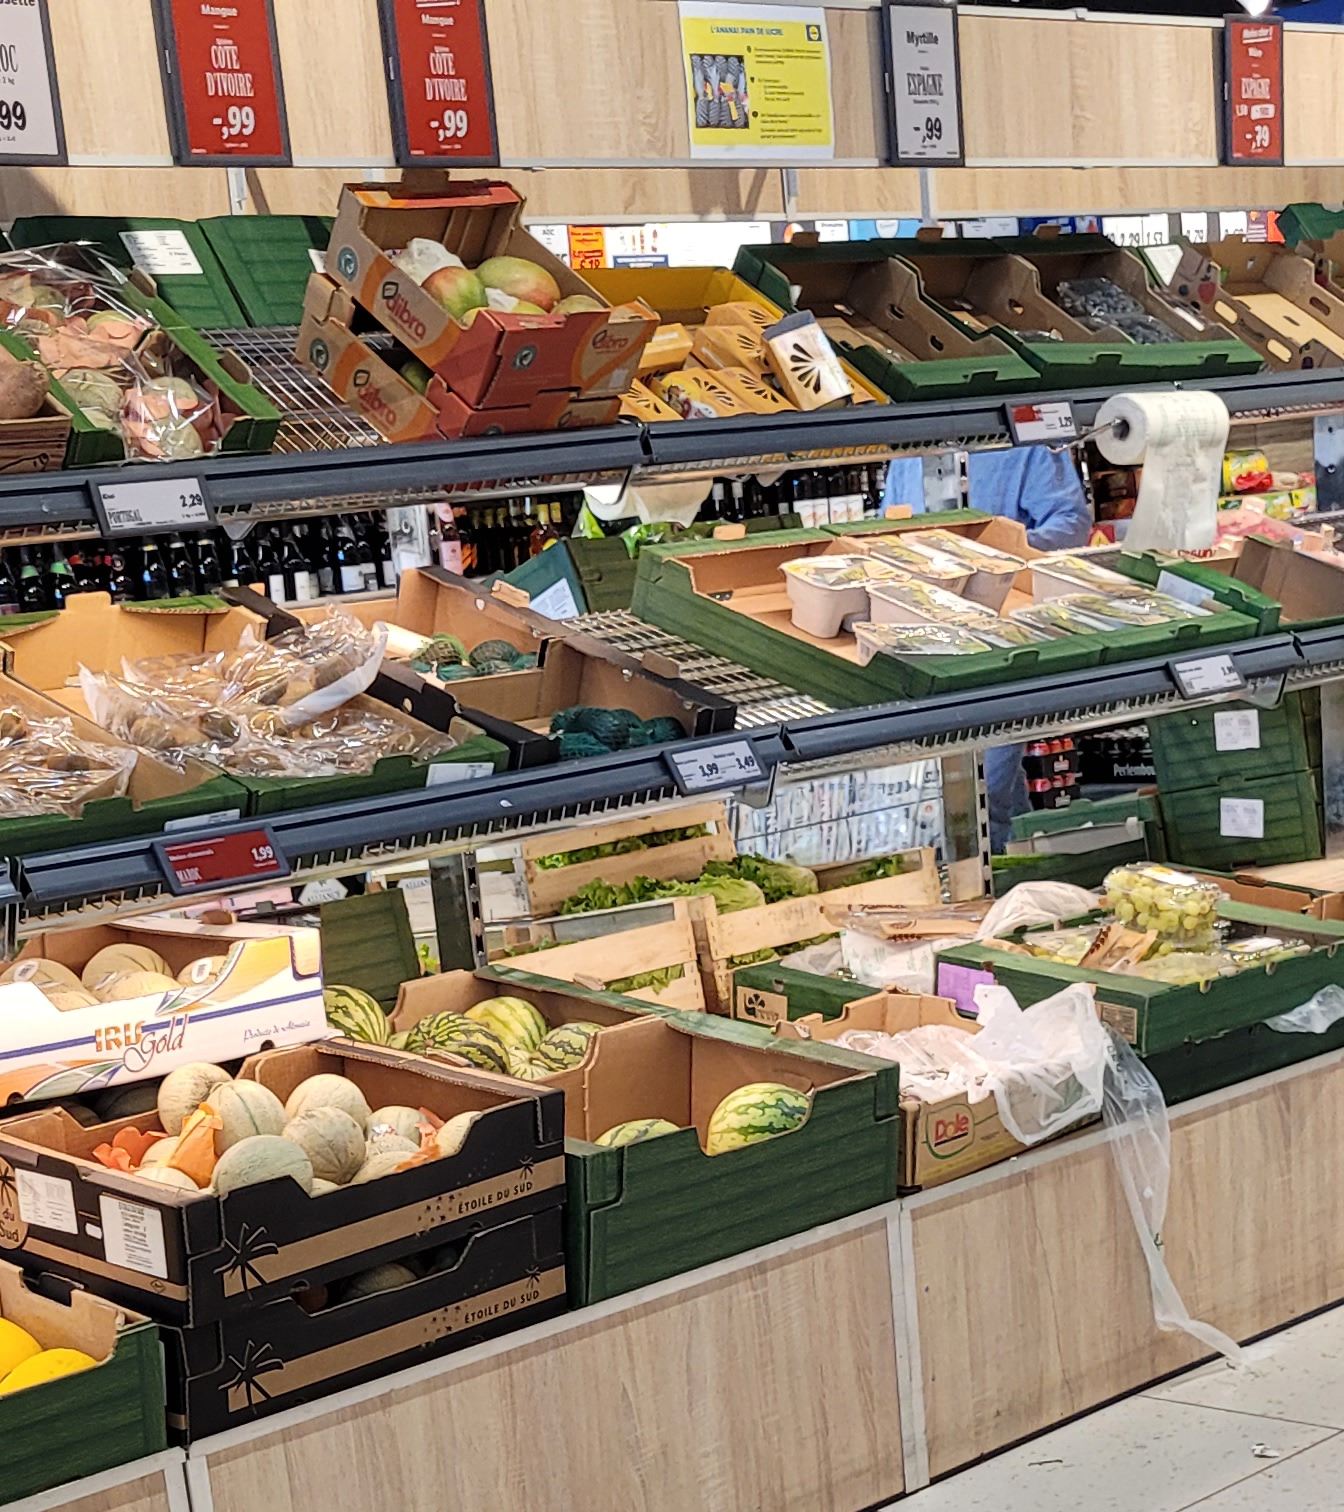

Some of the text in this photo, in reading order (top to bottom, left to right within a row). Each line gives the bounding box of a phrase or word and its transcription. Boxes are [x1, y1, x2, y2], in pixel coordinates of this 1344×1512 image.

[200, 4, 238, 17] Mangue
[421, 13, 455, 27] Mangue
[906, 30, 939, 47] Myrtille
[205, 72, 255, 97] D'IVOIRE
[424, 77, 468, 101] D'IVOIRE
[906, 72, 944, 96] ESPAGNE
[212, 105, 256, 140] -,99
[429, 109, 469, 142] -,99
[912, 116, 943, 144] -,99
[179, 493, 203, 509] 2,29
[251, 844, 275, 860] 1,99
[122, 1012, 189, 1074] Gold
[934, 1112, 970, 1141] Dole
[458, 1181, 534, 1214] ÉTOILE DU SUD
[464, 1290, 540, 1325] ÉTOILE DU SUD
